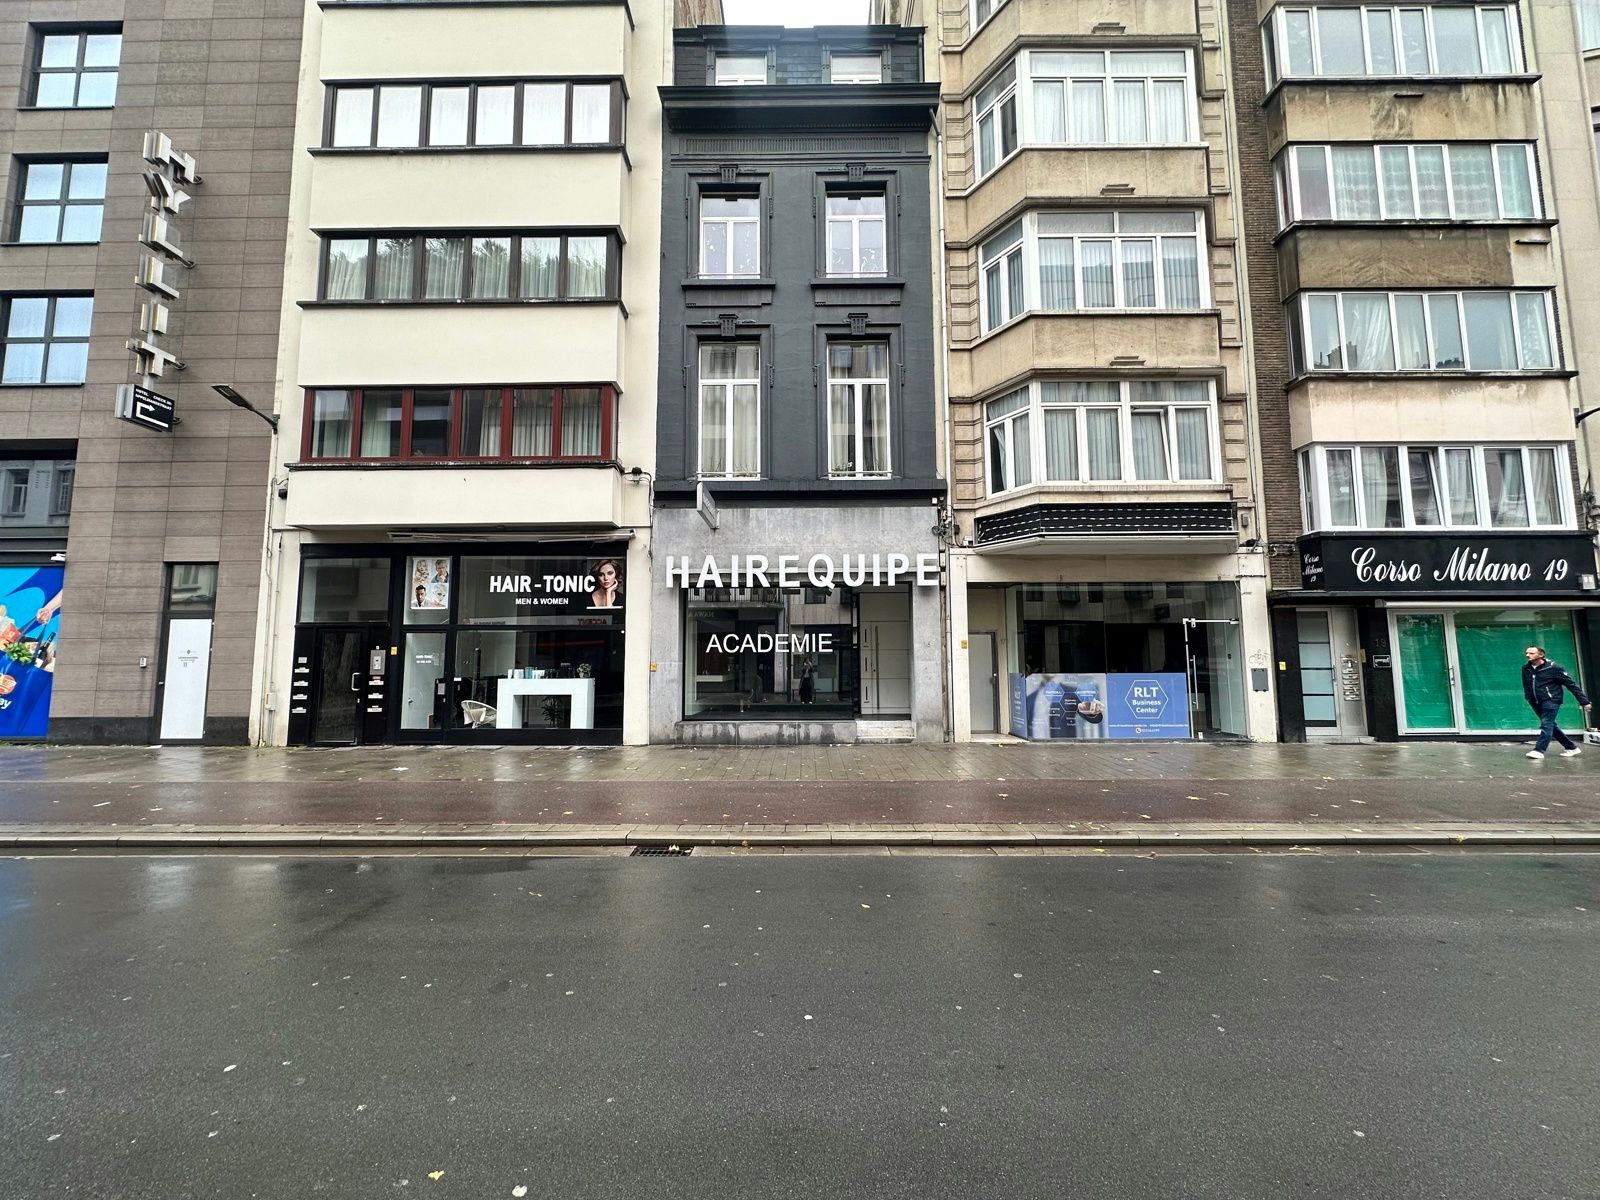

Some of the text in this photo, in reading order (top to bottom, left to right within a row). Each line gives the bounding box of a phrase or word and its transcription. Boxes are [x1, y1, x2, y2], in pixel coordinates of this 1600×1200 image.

[1303, 553, 1319, 564] Corso
[1351, 547, 1568, 582] Corso Milano 19
[665, 553, 939, 589] HAIREQUIPE
[1302, 564, 1323, 575] Milano
[706, 633, 833, 653] ACADEMIE
[1134, 687, 1159, 698] RLT
